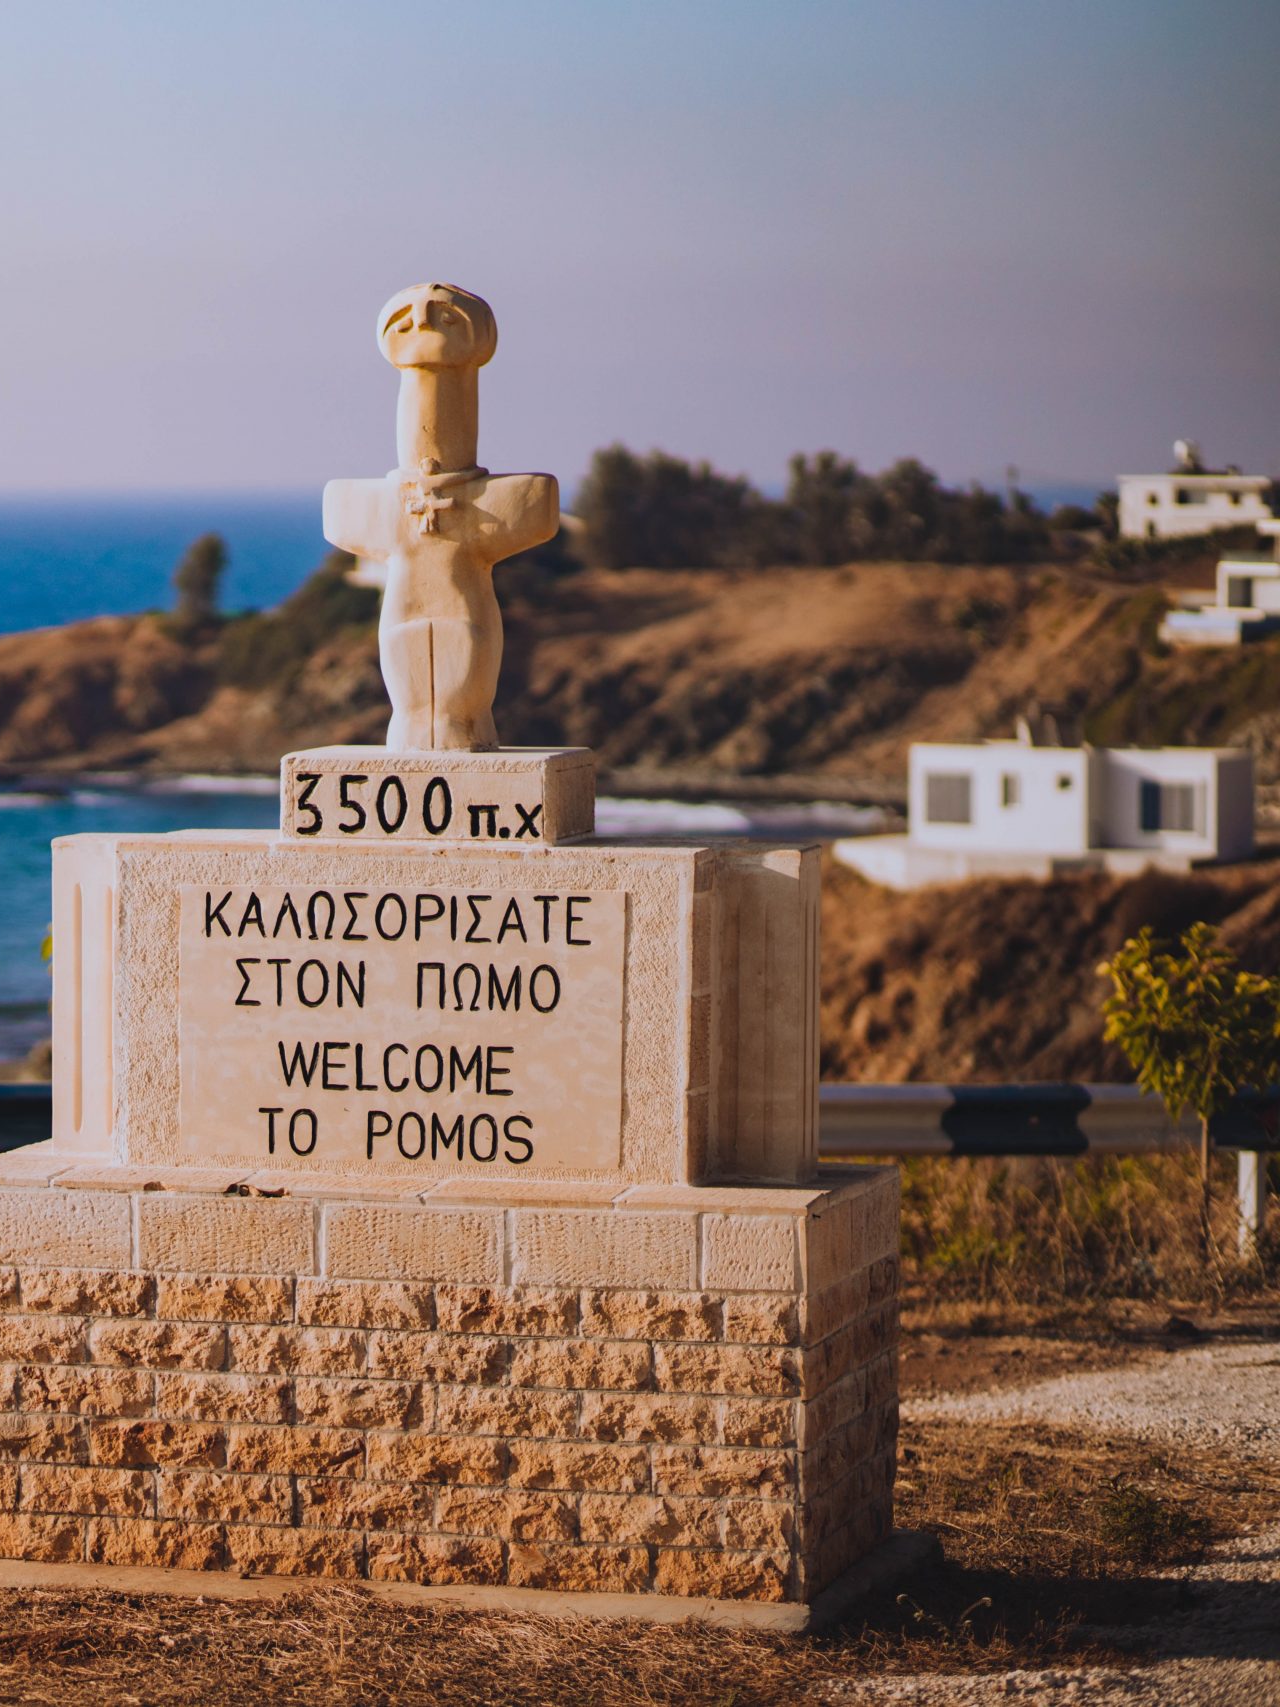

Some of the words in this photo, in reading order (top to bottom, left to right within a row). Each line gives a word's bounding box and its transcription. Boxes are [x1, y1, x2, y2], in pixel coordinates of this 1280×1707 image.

[295, 773, 453, 836] 3500
[204, 890, 592, 946] ΚΑΛΩΣΟΡΙΣΑΤΕ
[234, 957, 366, 1009] ΣΤΟΝ
[416, 961, 561, 1014] ΠΩΜΟ
[277, 1040, 515, 1097] WELCOME
[258, 1107, 318, 1157] TO
[366, 1110, 535, 1165] POMOS
